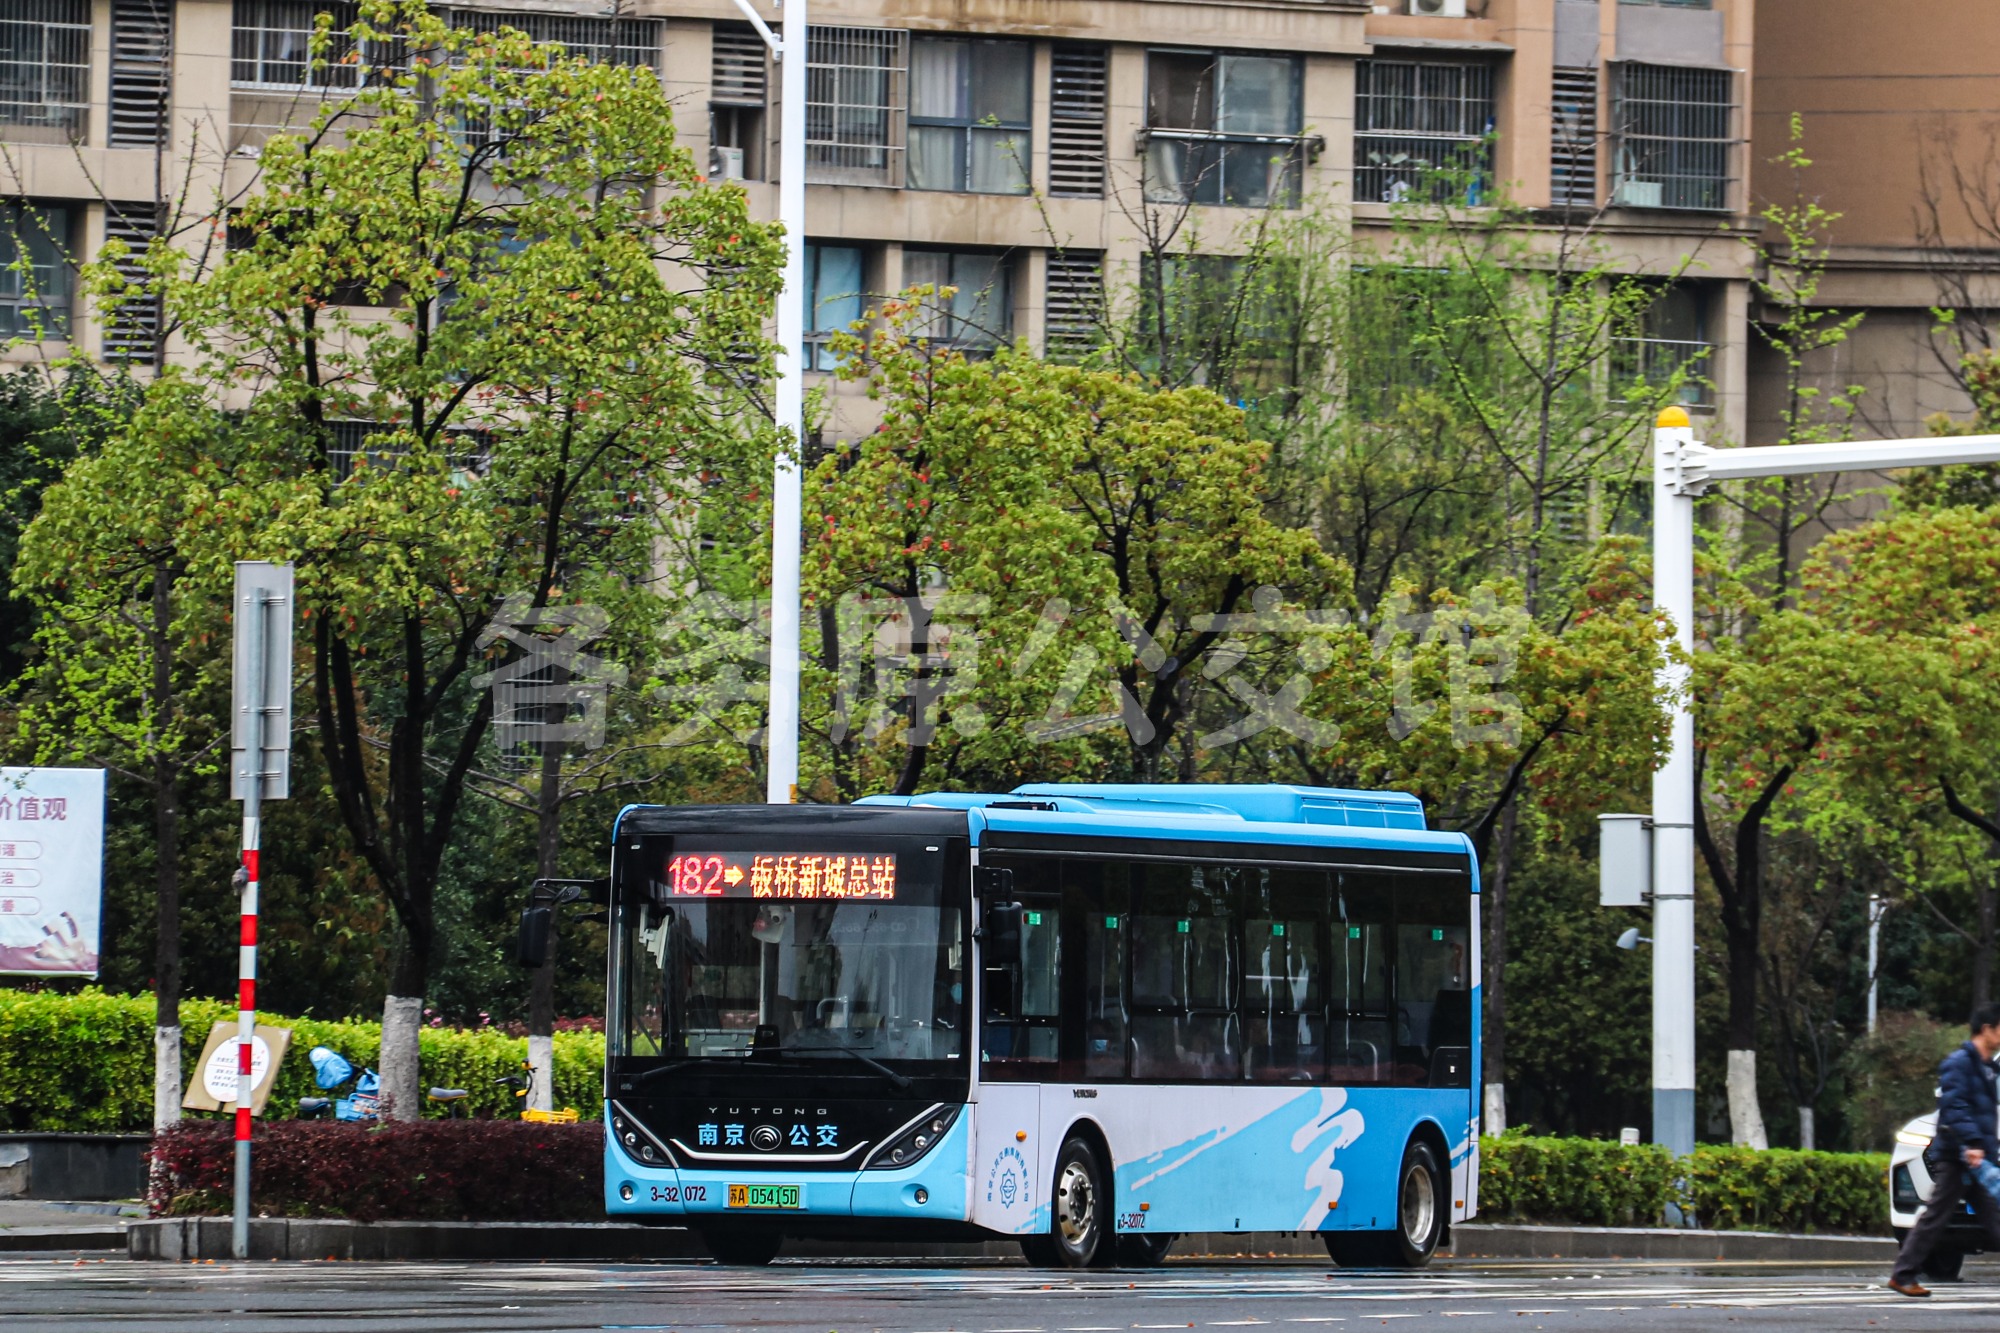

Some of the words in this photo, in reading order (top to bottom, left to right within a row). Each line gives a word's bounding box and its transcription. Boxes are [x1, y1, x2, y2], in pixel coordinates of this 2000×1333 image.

[668, 856, 724, 895] 182
[750, 856, 895, 898] 板桥新城总站
[708, 1107, 827, 1115] YUTONG
[698, 1123, 745, 1146] 南京
[788, 1124, 838, 1147] 公交
[1120, 1213, 1145, 1229] 3-32072
